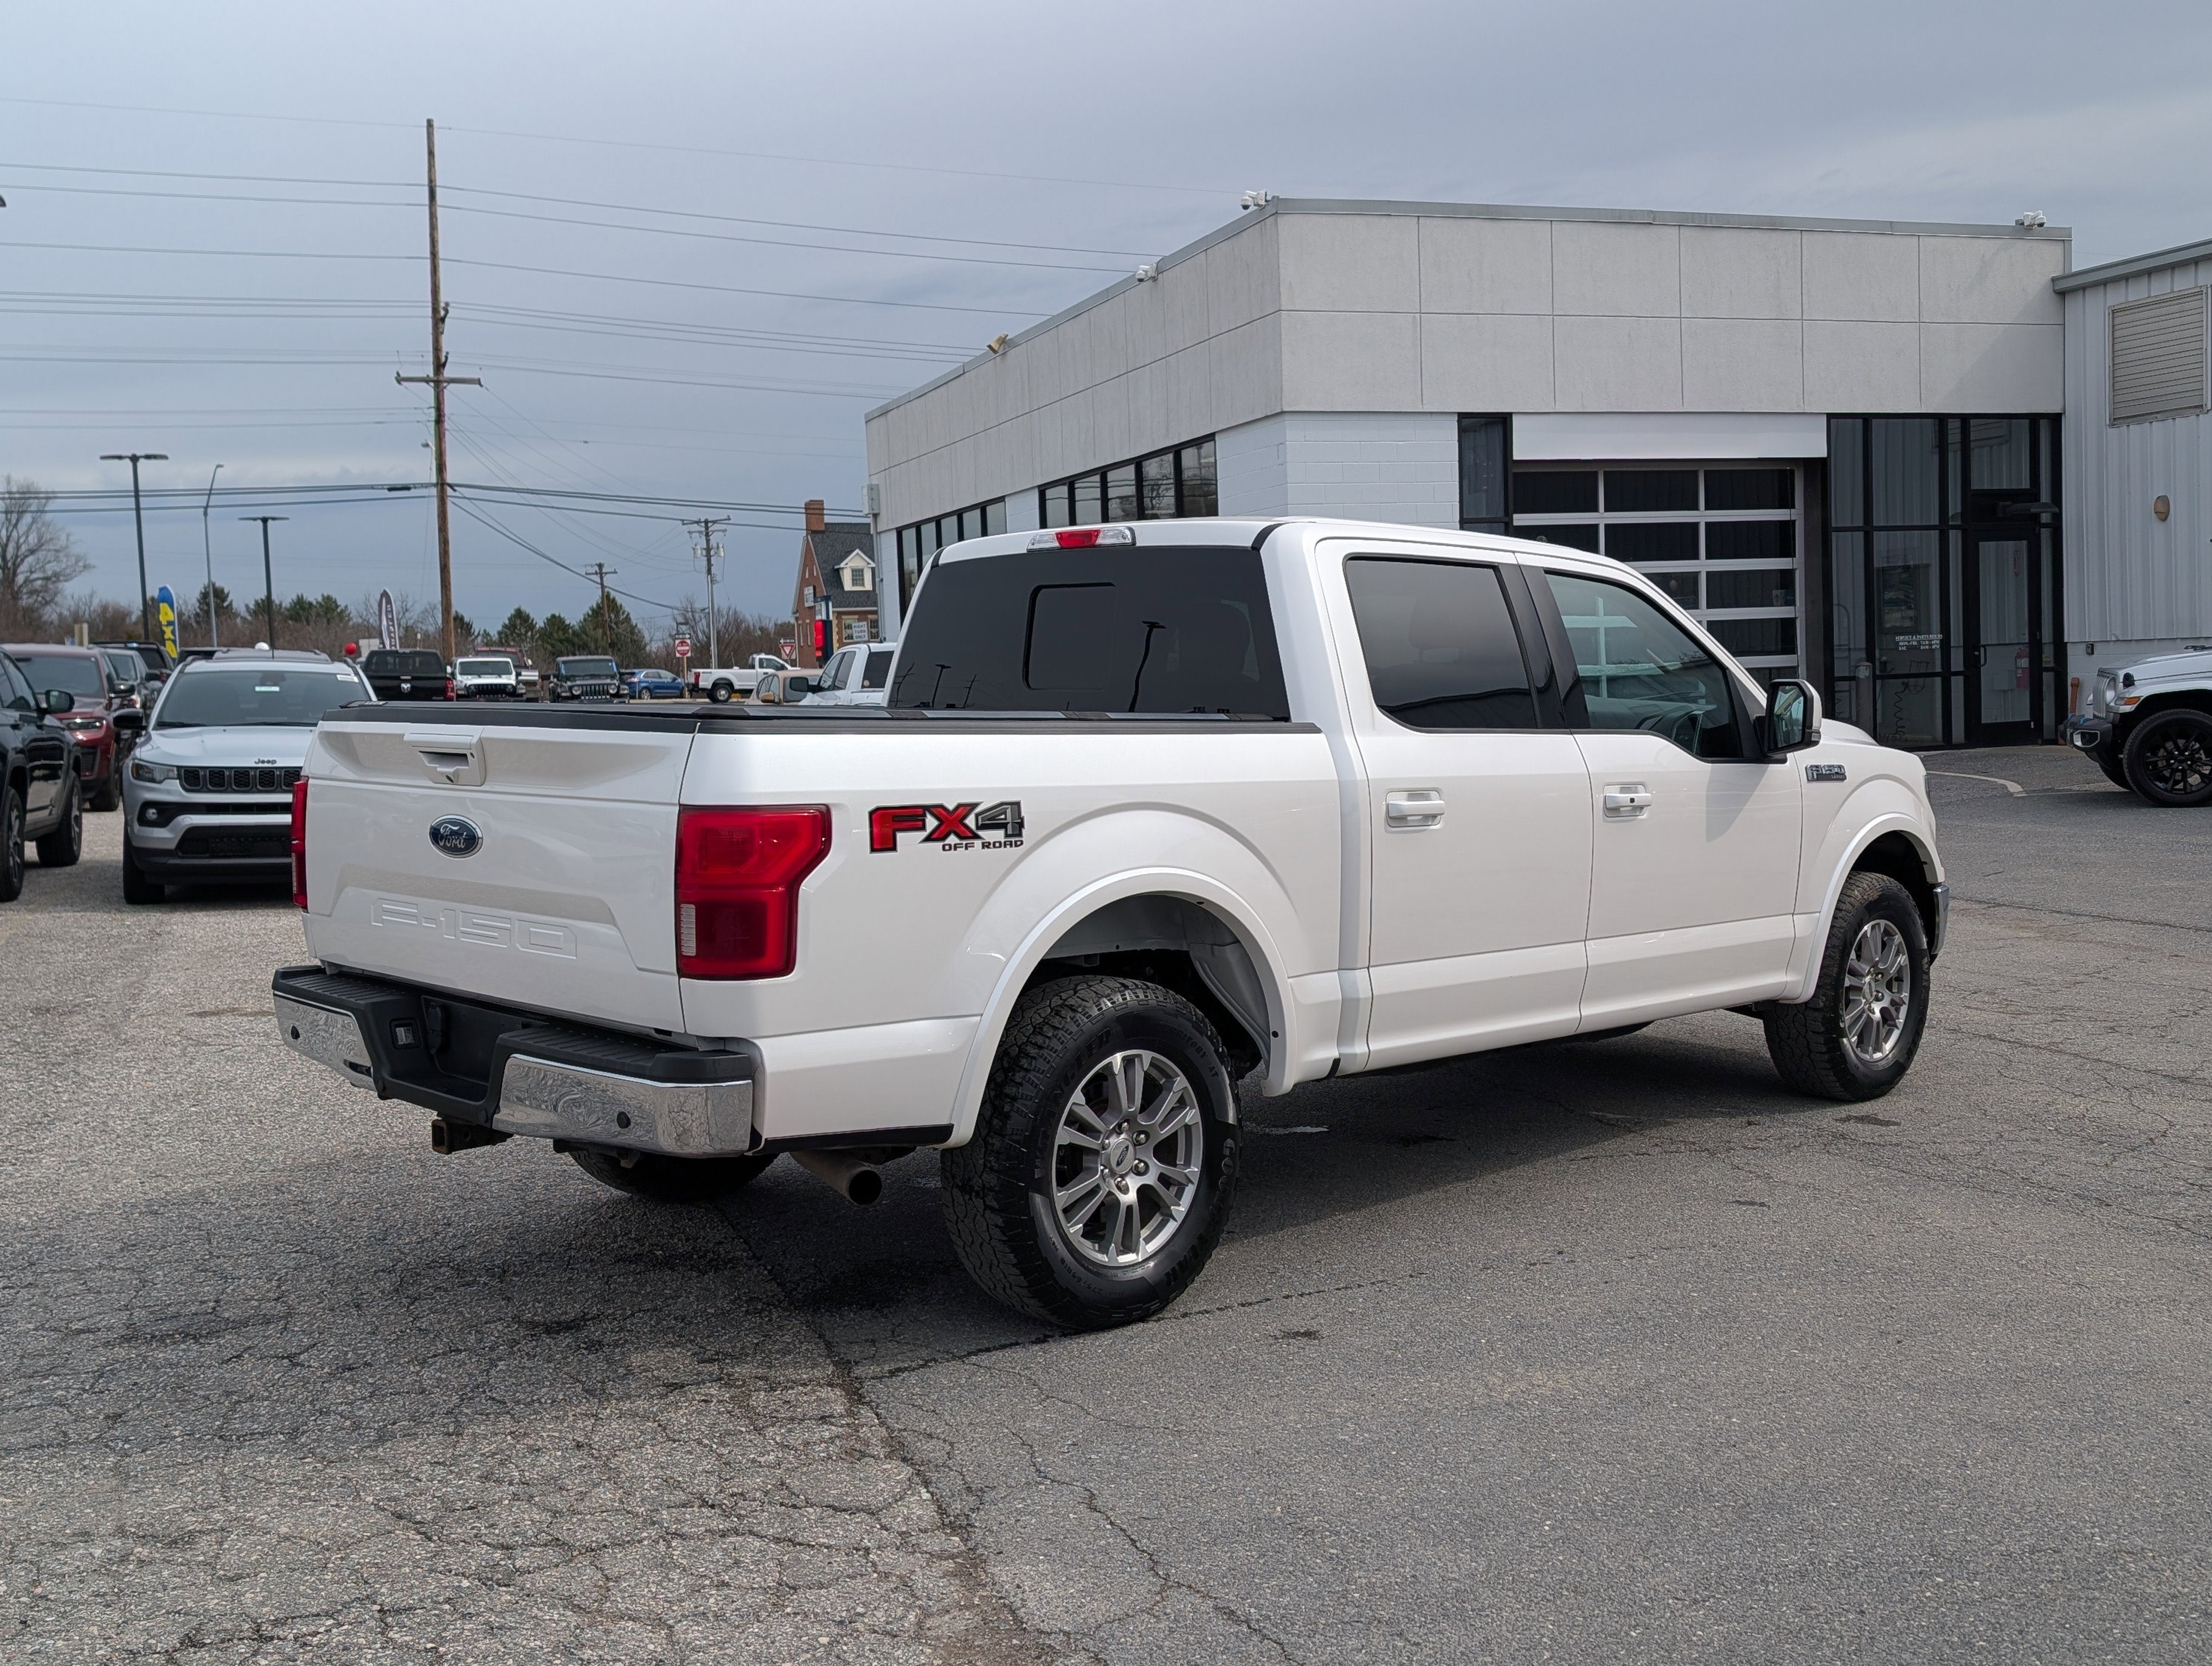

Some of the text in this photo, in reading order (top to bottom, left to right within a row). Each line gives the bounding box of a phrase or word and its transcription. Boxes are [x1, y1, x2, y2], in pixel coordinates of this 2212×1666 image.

[439, 823, 467, 849] Ford
[867, 800, 1025, 854] FX4
[941, 840, 1024, 852] OFF ROAD
[371, 897, 578, 959] F-150
